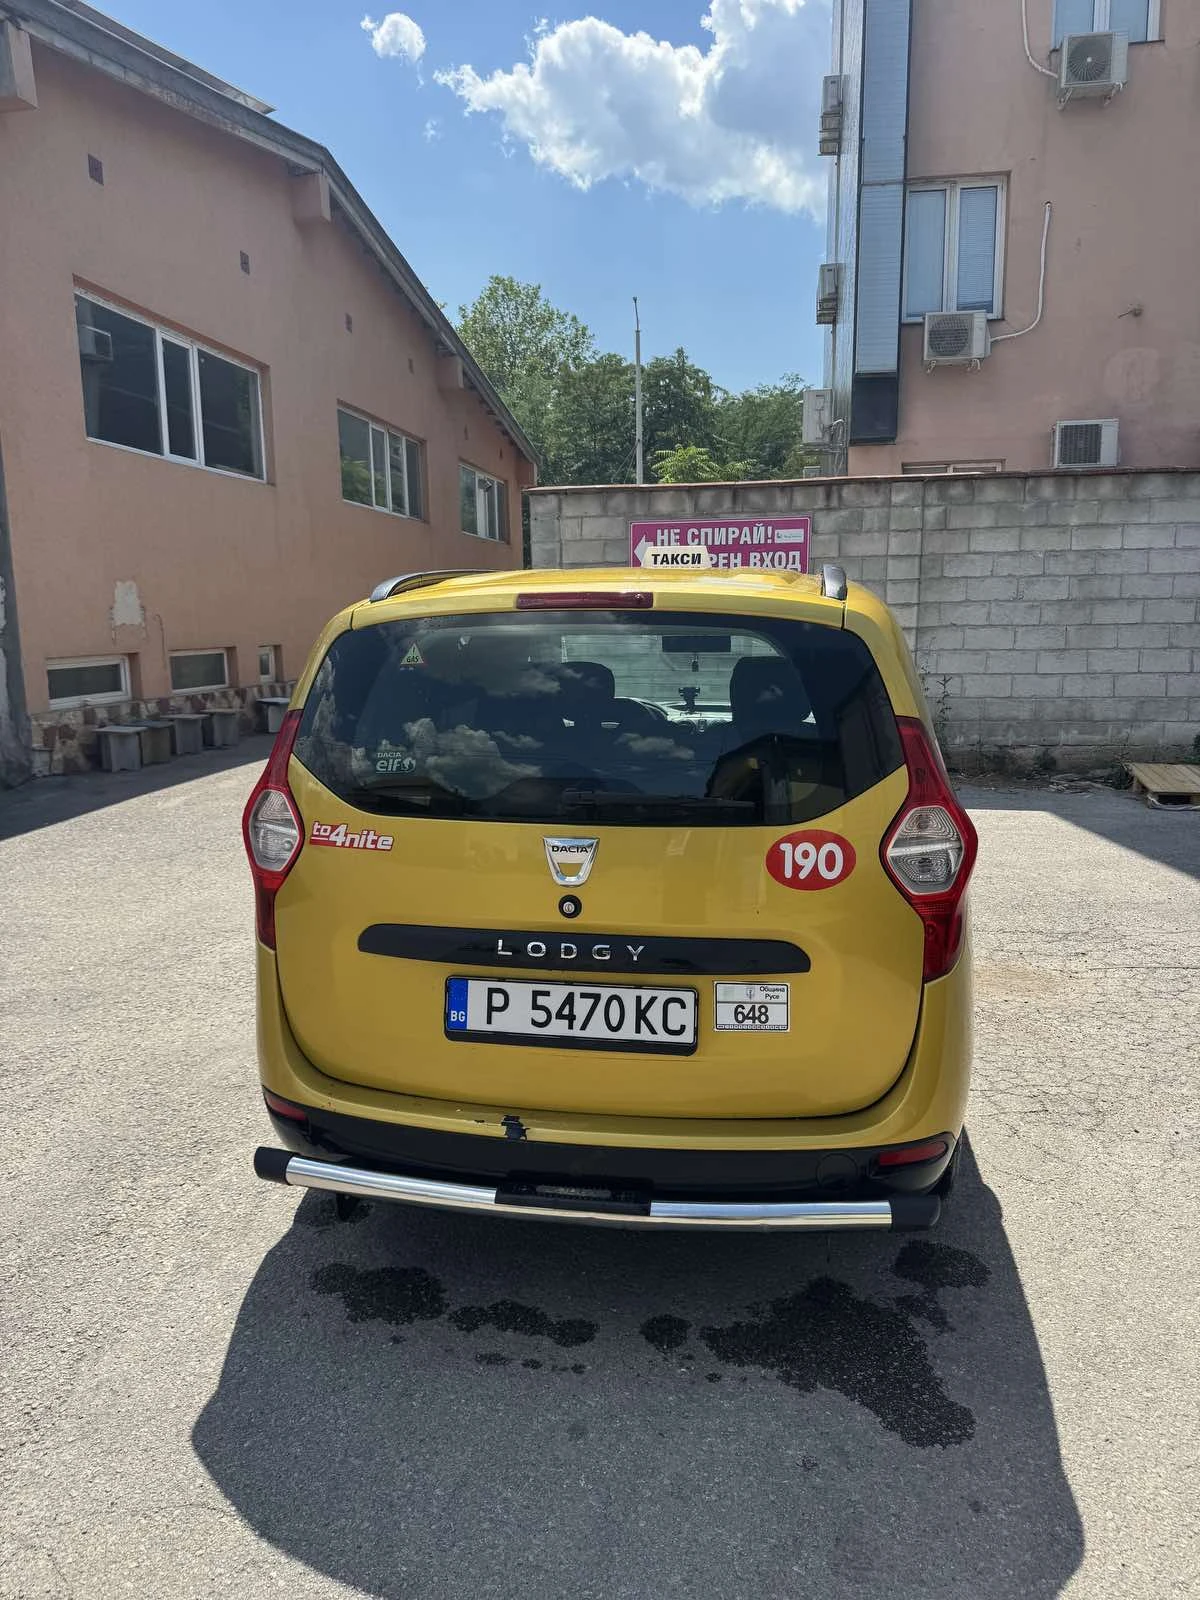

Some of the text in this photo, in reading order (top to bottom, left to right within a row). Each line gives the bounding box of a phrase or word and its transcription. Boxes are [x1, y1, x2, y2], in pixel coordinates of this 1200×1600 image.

[656, 523, 773, 546] НЕ СПИРАЙ!
[651, 553, 702, 566] ТАКСИ
[710, 551, 801, 571] РЕН ВХОД
[406, 655, 419, 663] GAS
[377, 751, 402, 759] DACIA
[551, 845, 589, 854] DACIA
[779, 842, 844, 880] 190
[497, 939, 645, 961] LODGY
[764, 993, 780, 1001] Русе
[450, 1010, 466, 1023] BG
[531, 990, 626, 1033] 5470
[733, 1004, 770, 1024] 648
